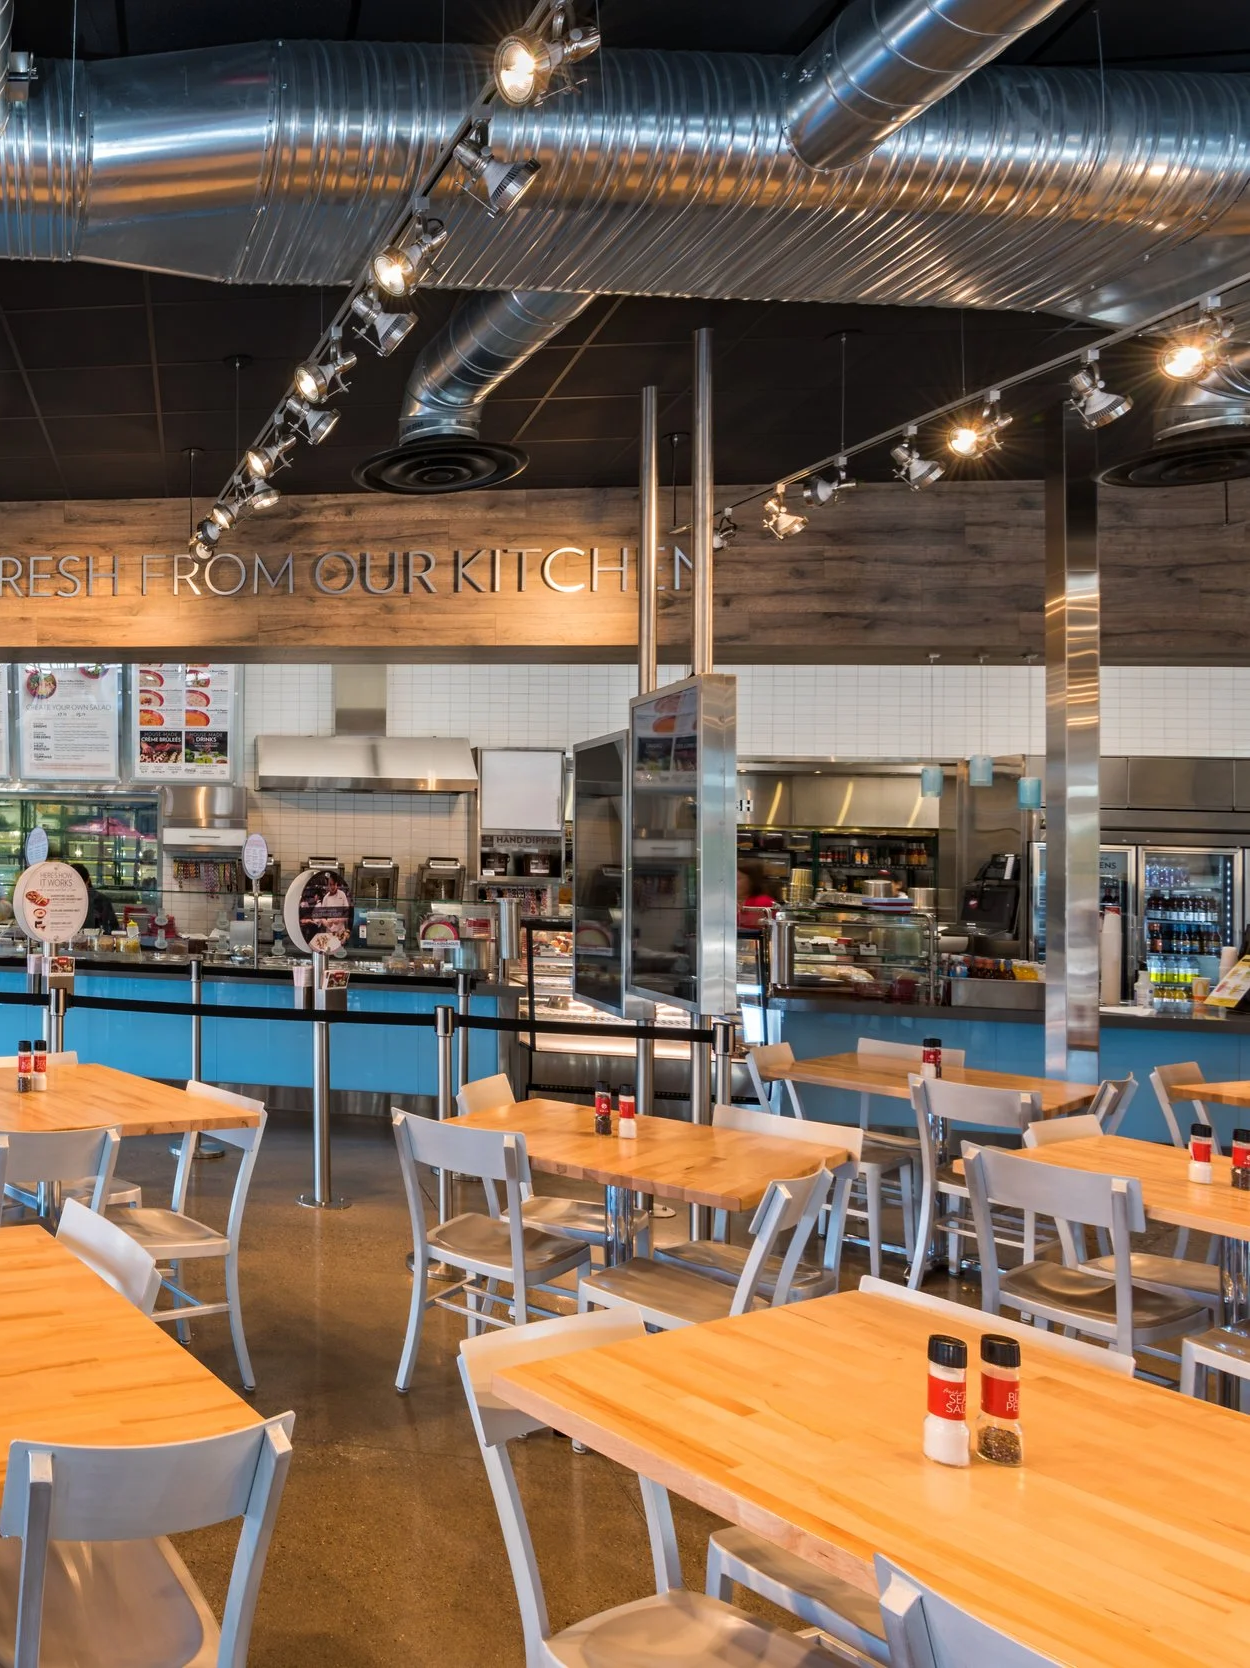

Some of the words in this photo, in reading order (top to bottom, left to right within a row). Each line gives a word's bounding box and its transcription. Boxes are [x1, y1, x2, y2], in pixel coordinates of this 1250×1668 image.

[141, 551, 295, 597] FROM
[314, 549, 438, 595] OUR
[496, 836, 523, 844] HAND
[525, 836, 559, 845] DIPPED
[39, 879, 46, 887] IT
[47, 879, 73, 887] WORKS
[945, 1402, 967, 1414] SAL
